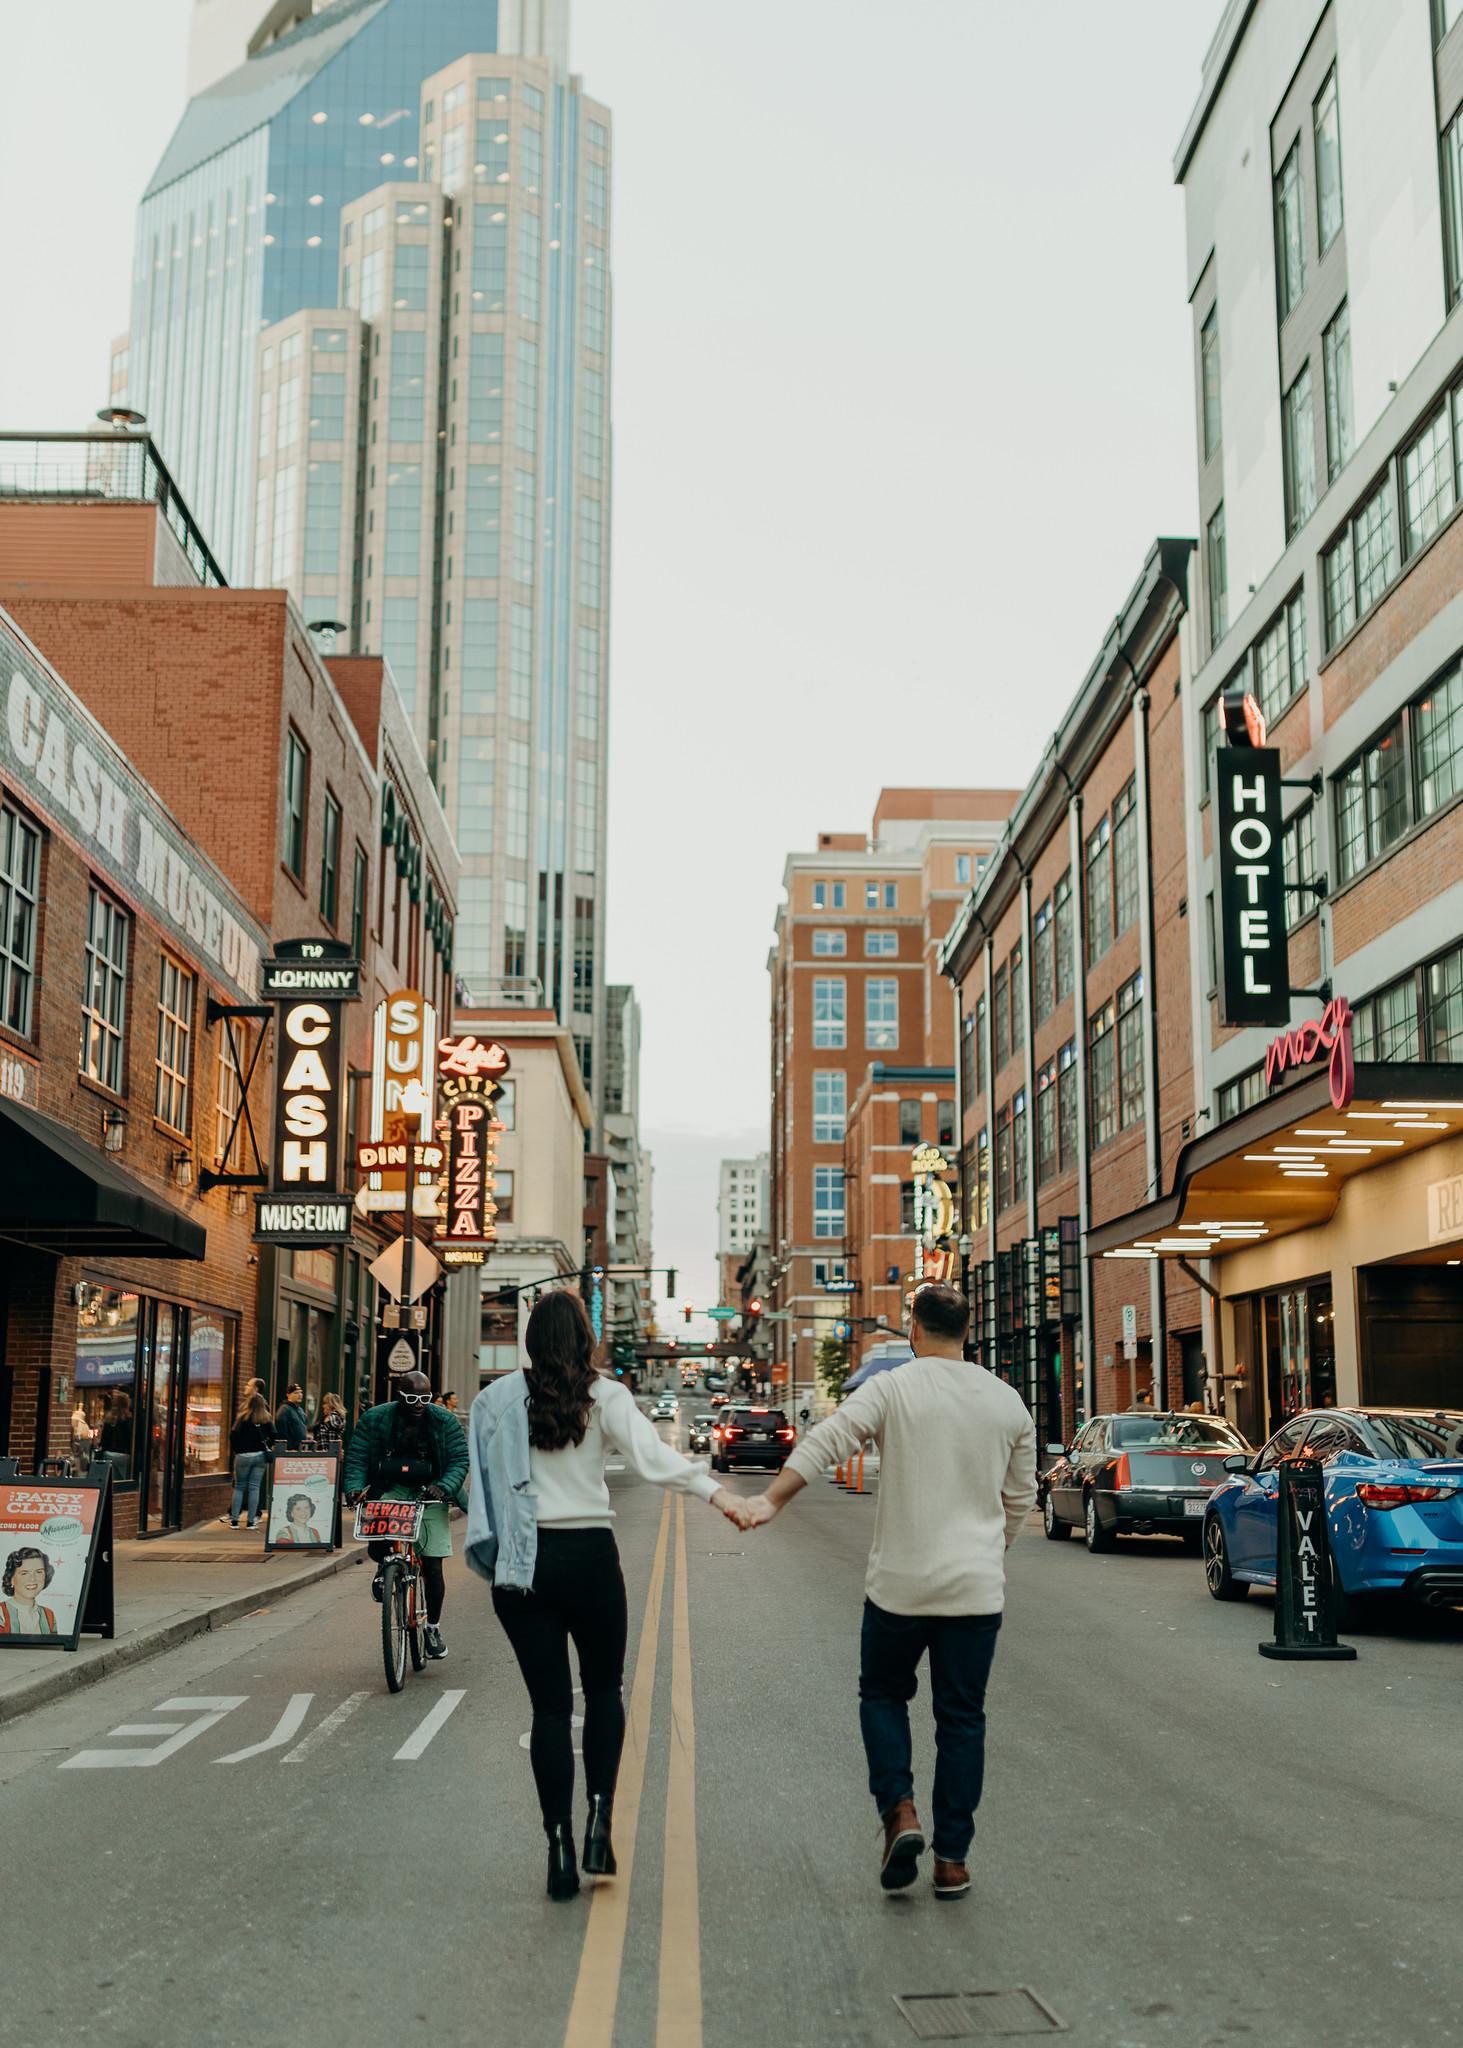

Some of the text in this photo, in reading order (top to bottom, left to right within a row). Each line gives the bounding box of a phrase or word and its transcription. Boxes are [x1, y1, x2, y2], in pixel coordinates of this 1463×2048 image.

[8, 670, 260, 1001] CASH MUSEUM
[1230, 773, 1272, 994] HOTEL
[268, 970, 354, 988] JOHNNY
[1265, 996, 1354, 1110] moxy
[1, 1058, 25, 1100] 119
[282, 1003, 332, 1182] CASH
[443, 1075, 498, 1097] CITY
[451, 1105, 484, 1236] PIZZA
[260, 1204, 347, 1232] MUSEUM
[6, 1502, 82, 1515] CLINE
[15, 1491, 84, 1504] PATSY
[365, 1502, 416, 1518] BEWARE
[362, 1519, 412, 1536] of DOG
[1296, 1510, 1318, 1632] VALET
